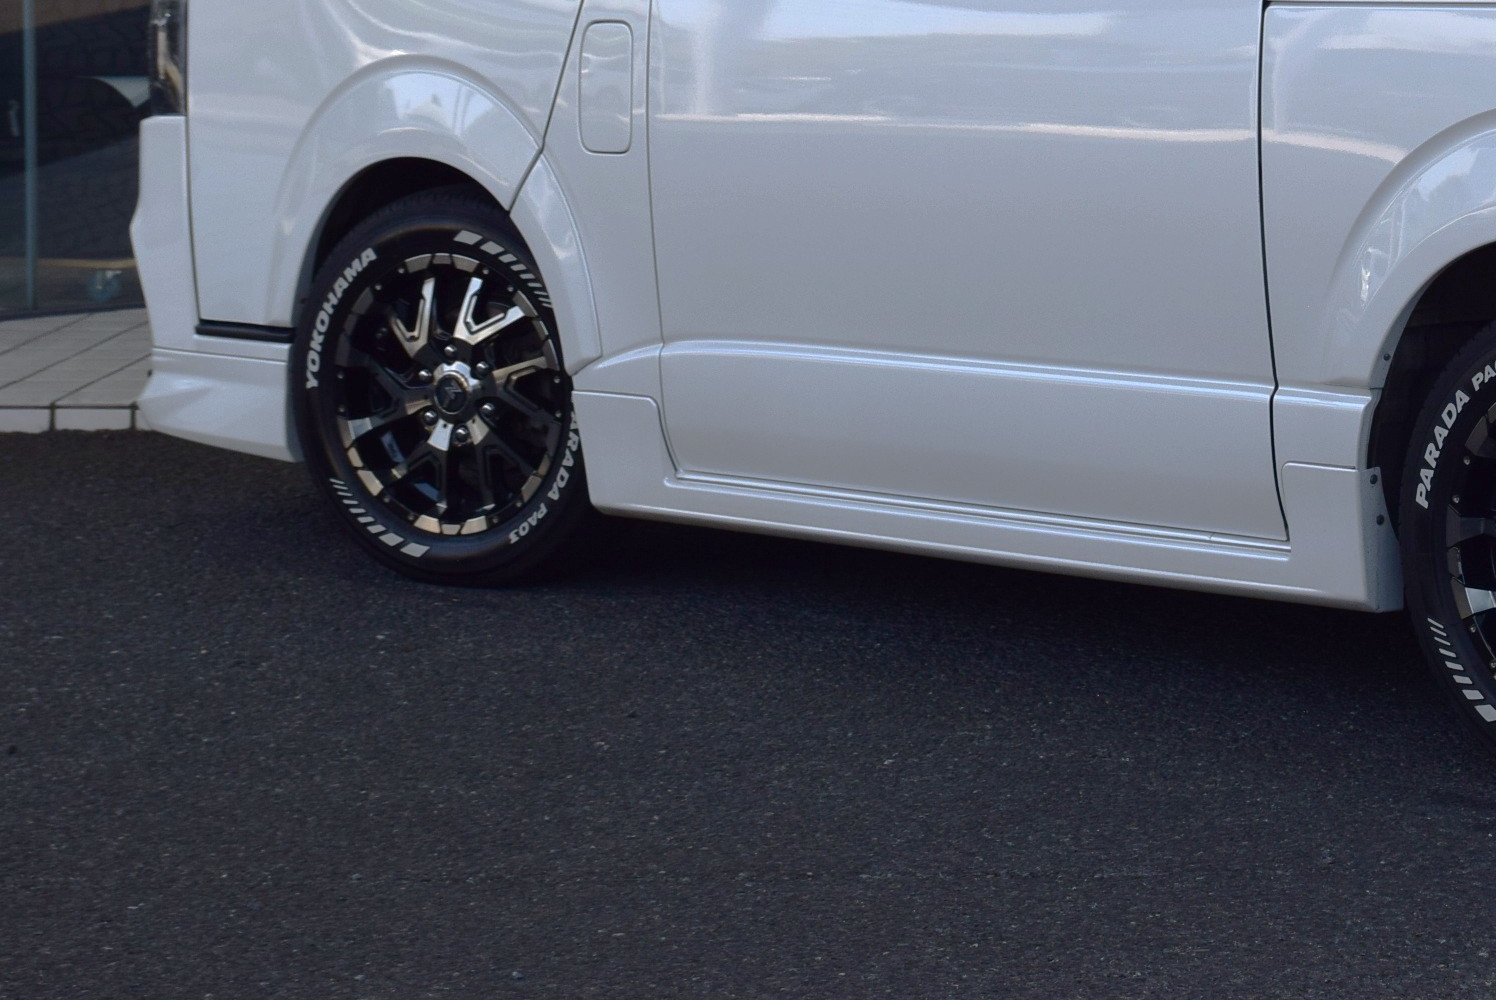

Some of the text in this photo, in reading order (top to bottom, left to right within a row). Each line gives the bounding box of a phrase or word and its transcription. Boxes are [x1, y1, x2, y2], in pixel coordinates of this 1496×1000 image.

[306, 247, 378, 389] YOKOHAMA
[547, 410, 580, 501] ARADA
[1415, 389, 1470, 509] PARADA
